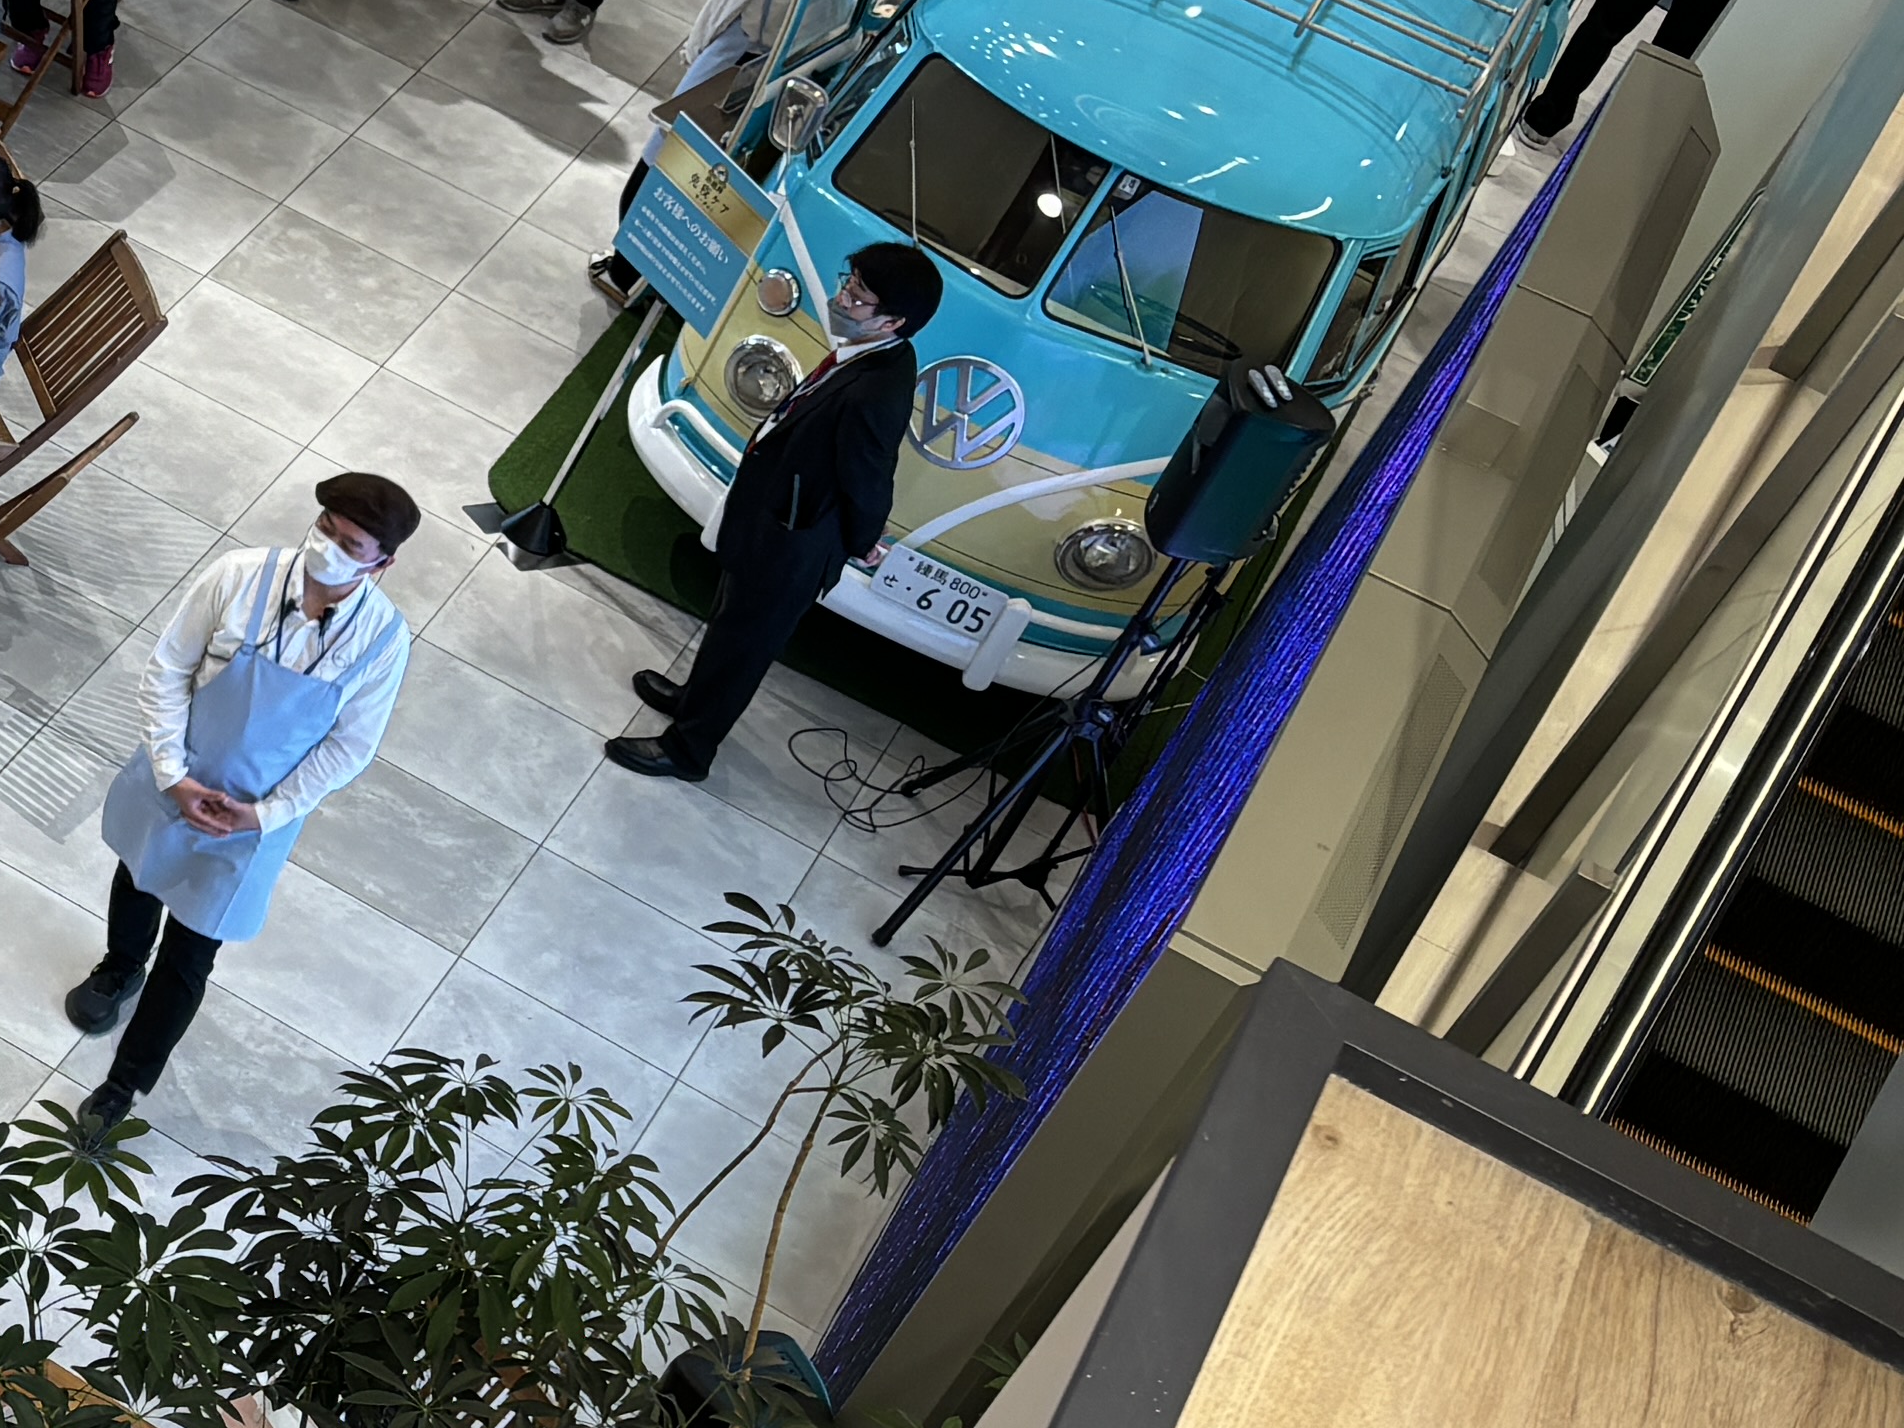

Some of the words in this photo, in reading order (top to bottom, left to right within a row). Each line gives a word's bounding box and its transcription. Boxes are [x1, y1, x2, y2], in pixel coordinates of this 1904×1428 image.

[653, 186, 730, 265] お客様へのお願い
[883, 574, 898, 588] せ
[915, 561, 949, 585] 練馬
[949, 578, 981, 600] 800
